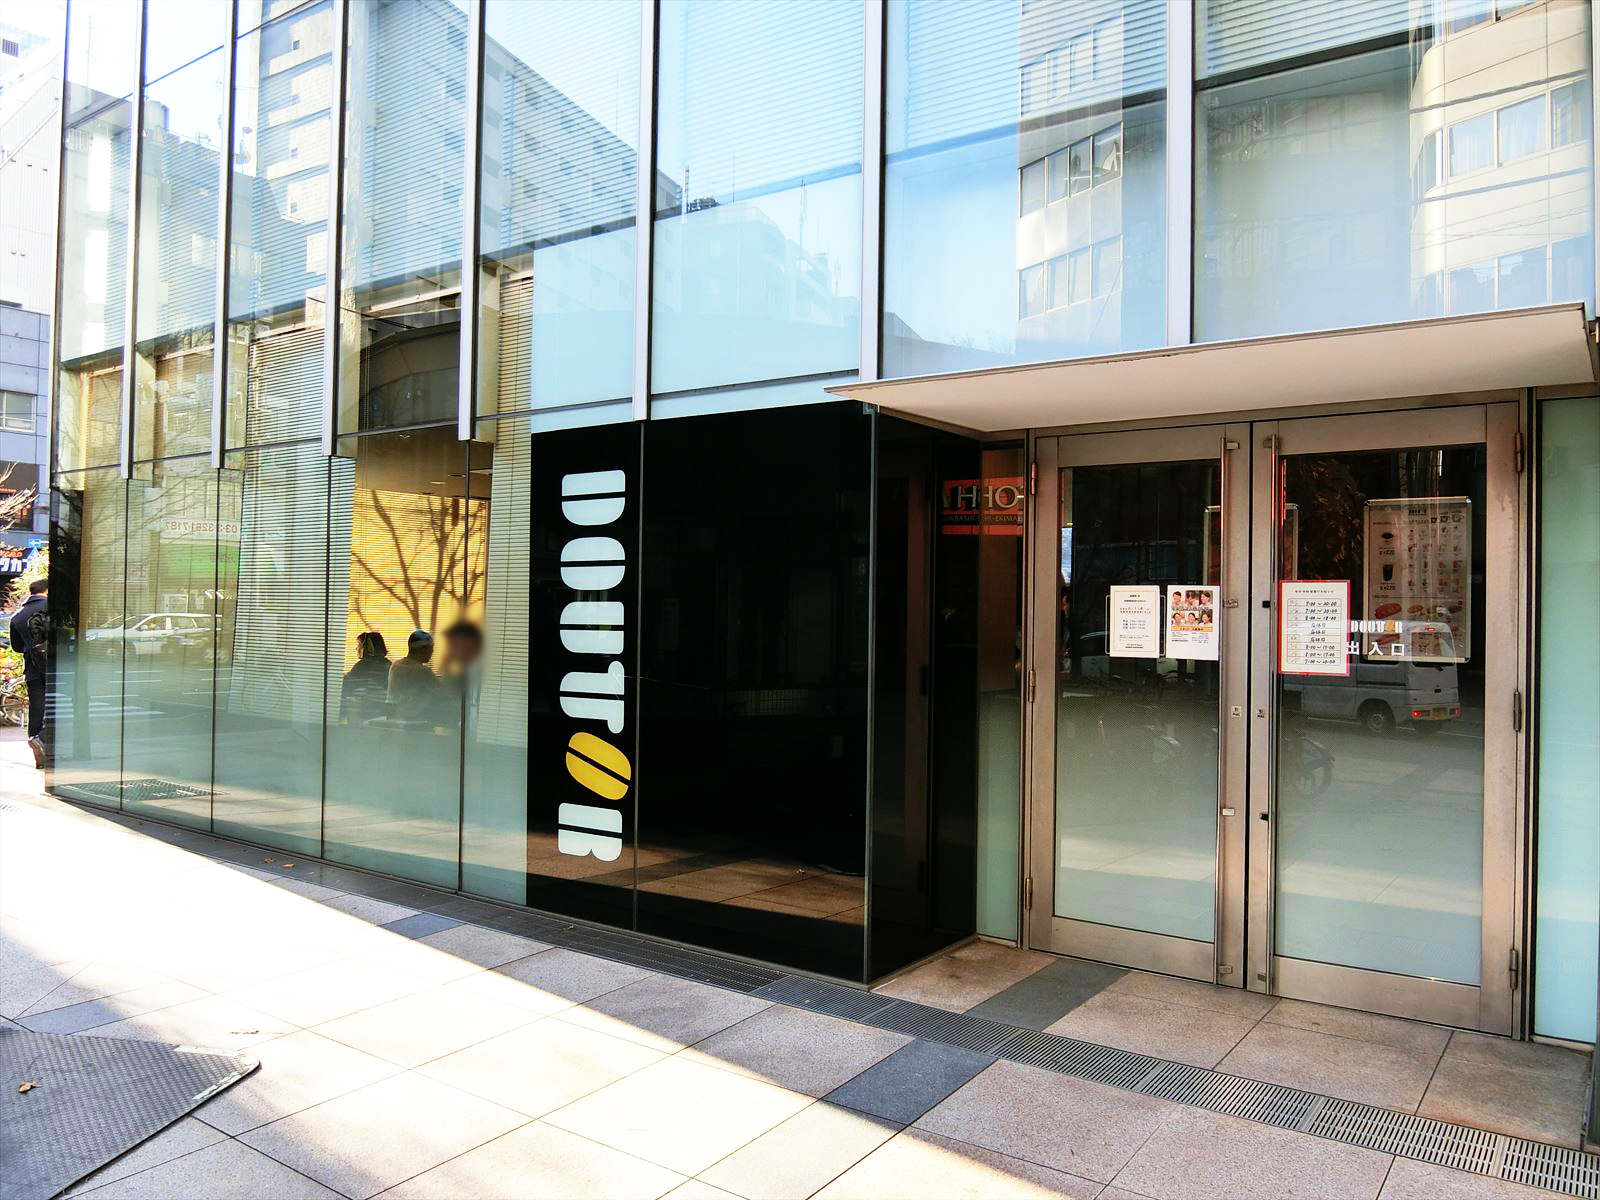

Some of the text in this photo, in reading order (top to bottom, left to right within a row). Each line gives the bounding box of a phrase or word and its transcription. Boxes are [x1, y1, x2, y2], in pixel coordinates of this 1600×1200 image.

[557, 469, 632, 862] DOUTOR
[1345, 641, 1405, 656] 出入口
